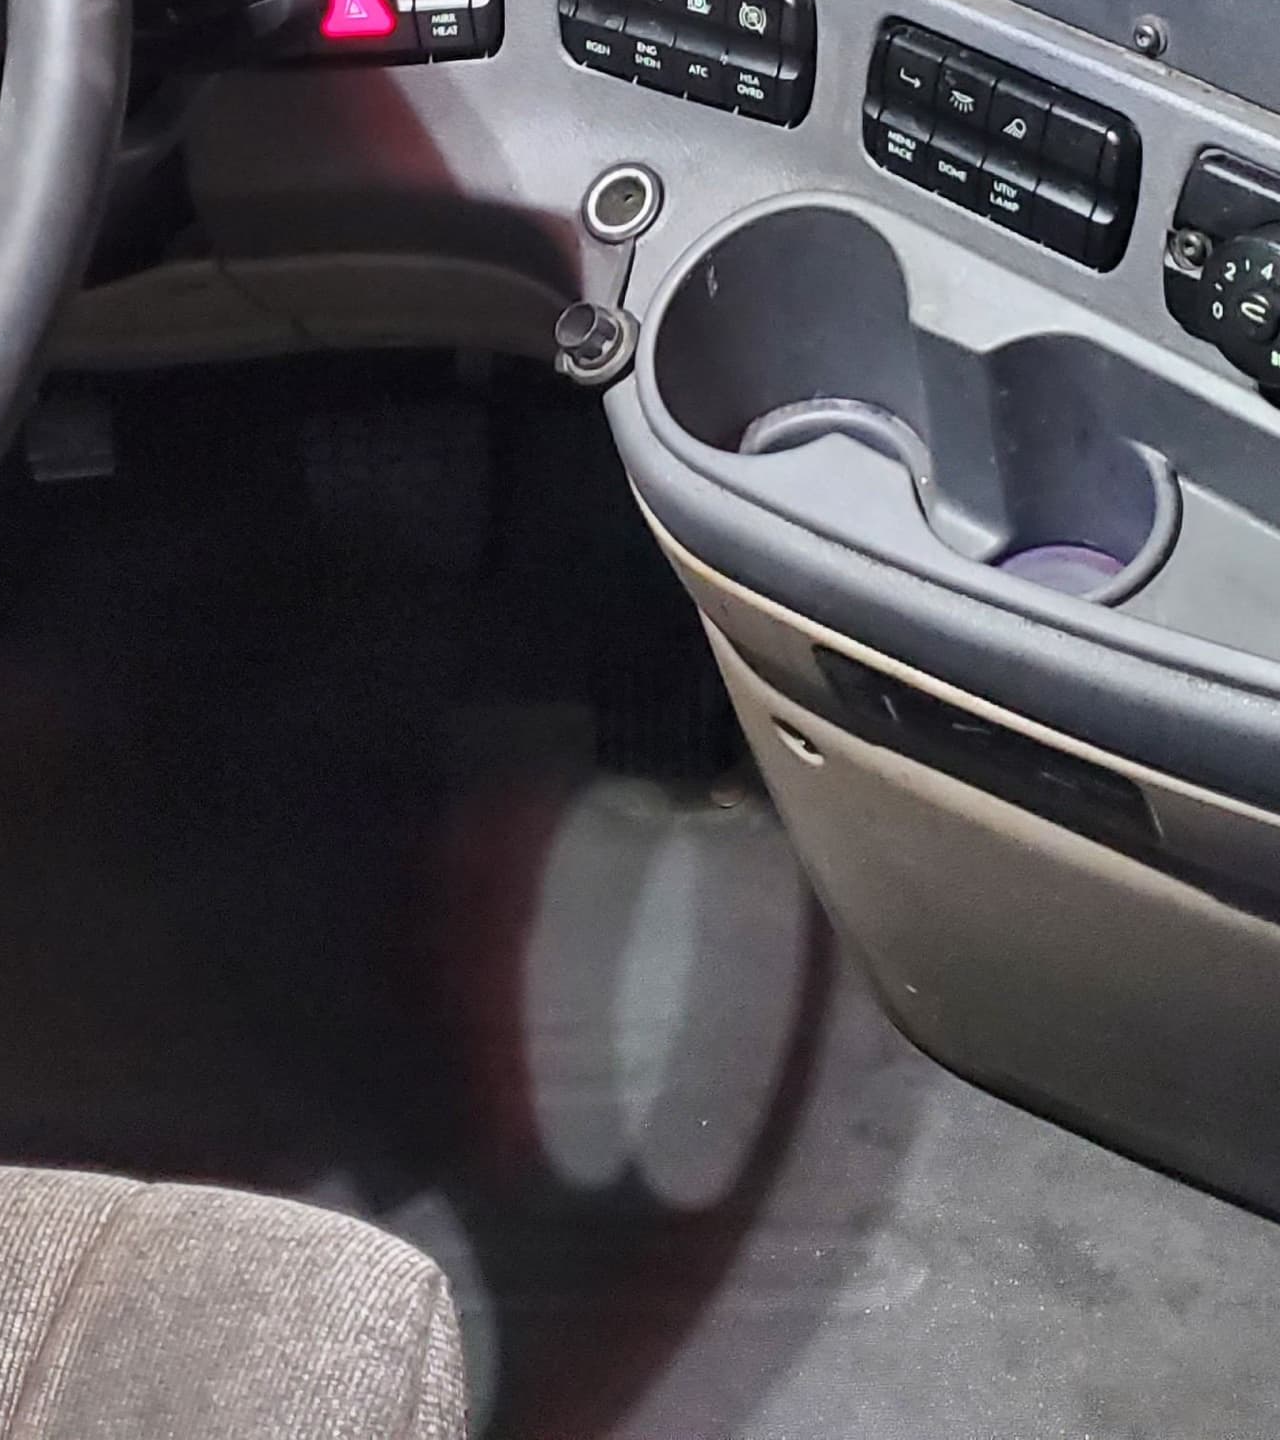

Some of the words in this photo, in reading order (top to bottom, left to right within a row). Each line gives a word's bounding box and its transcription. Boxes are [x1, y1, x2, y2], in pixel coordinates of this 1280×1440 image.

[432, 25, 458, 36] HEAT
[637, 41, 657, 56] ENG
[688, 64, 709, 78] ATC
[739, 72, 760, 87] HSA
[737, 84, 765, 100] OVRD
[888, 141, 912, 161] BACK
[938, 160, 967, 182] DOME
[990, 192, 1019, 212] LAMP
[1224, 262, 1236, 281] 2
[1261, 263, 1273, 280] 4
[1212, 301, 1223, 319] 0
